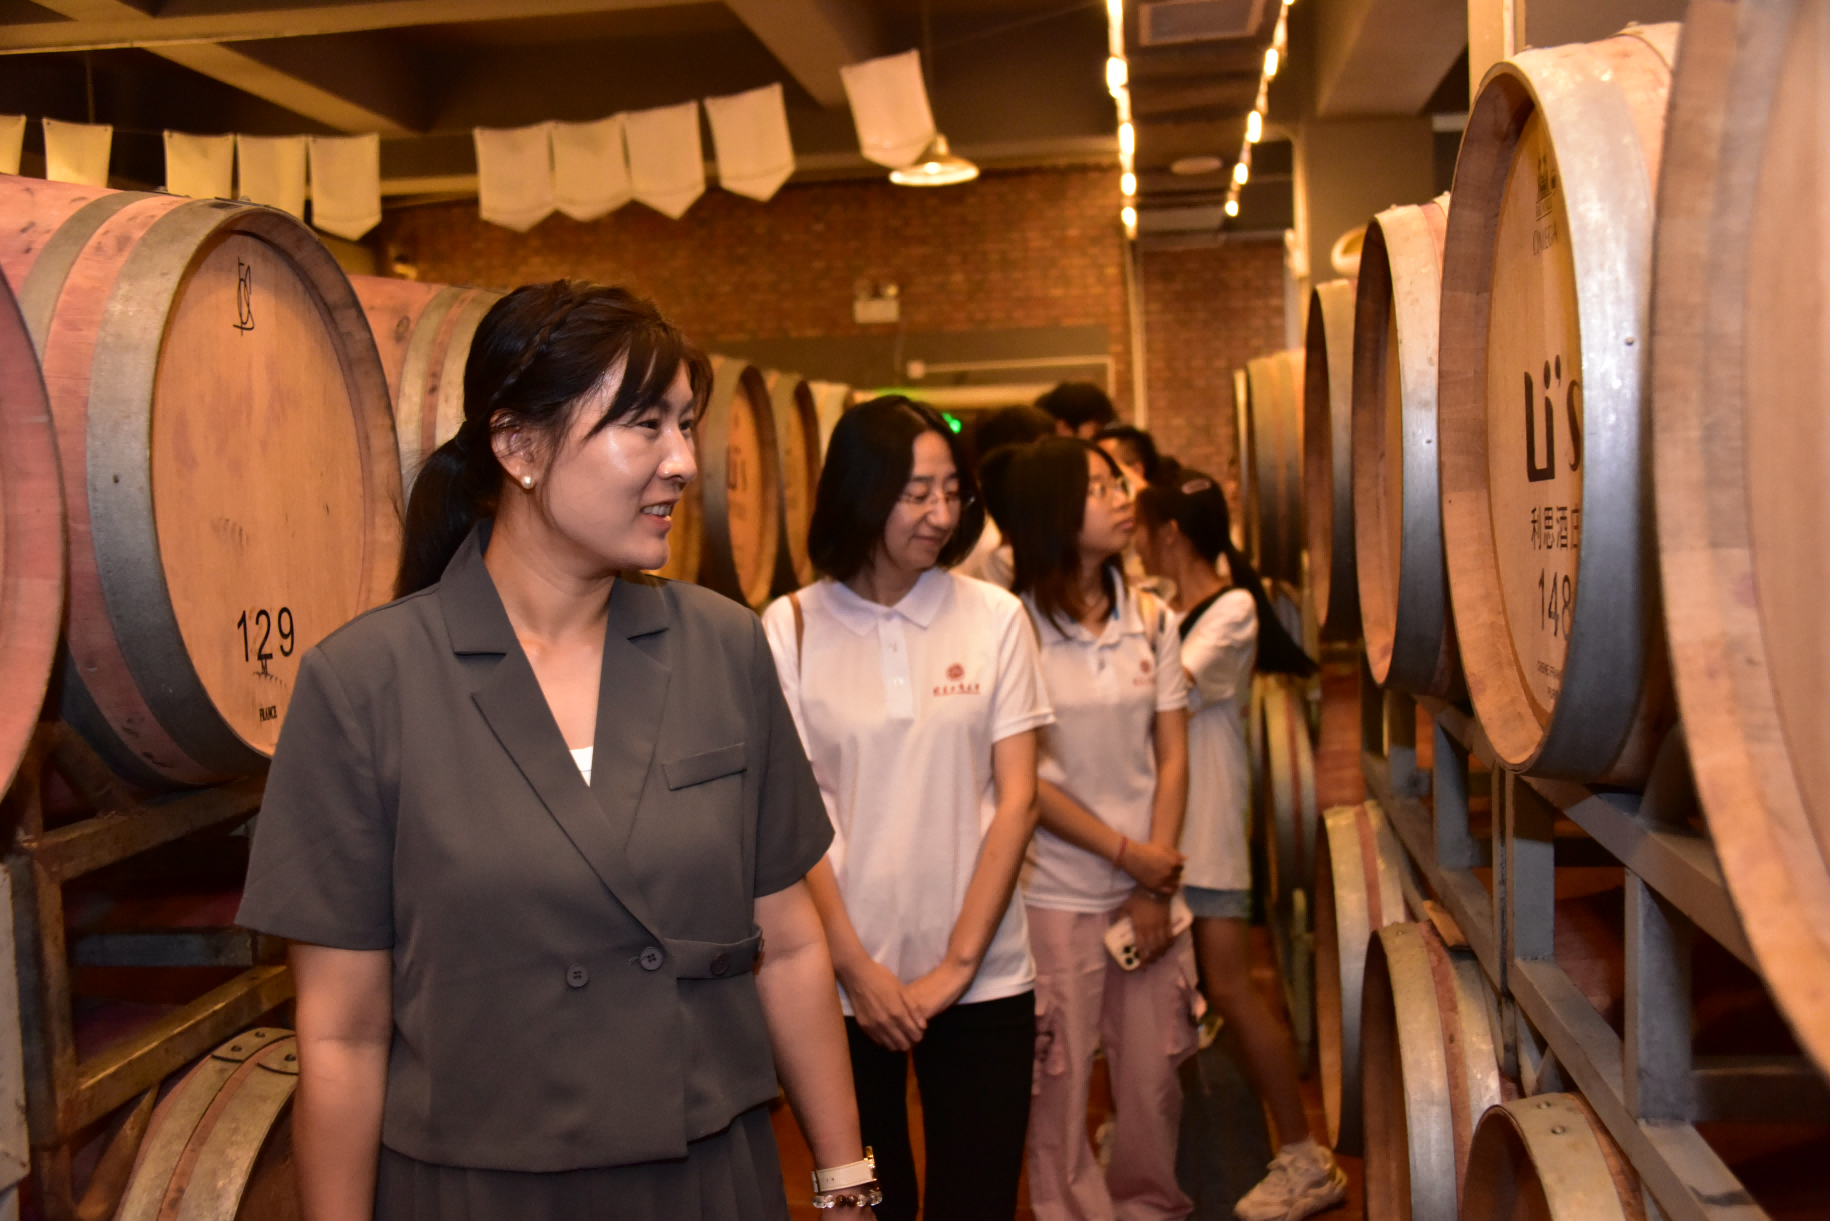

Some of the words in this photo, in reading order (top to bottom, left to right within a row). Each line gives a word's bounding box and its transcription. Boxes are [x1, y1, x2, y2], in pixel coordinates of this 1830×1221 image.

[1538, 567, 1572, 641] 148
[237, 606, 294, 662] 129
[259, 705, 277, 722] FRANCE
